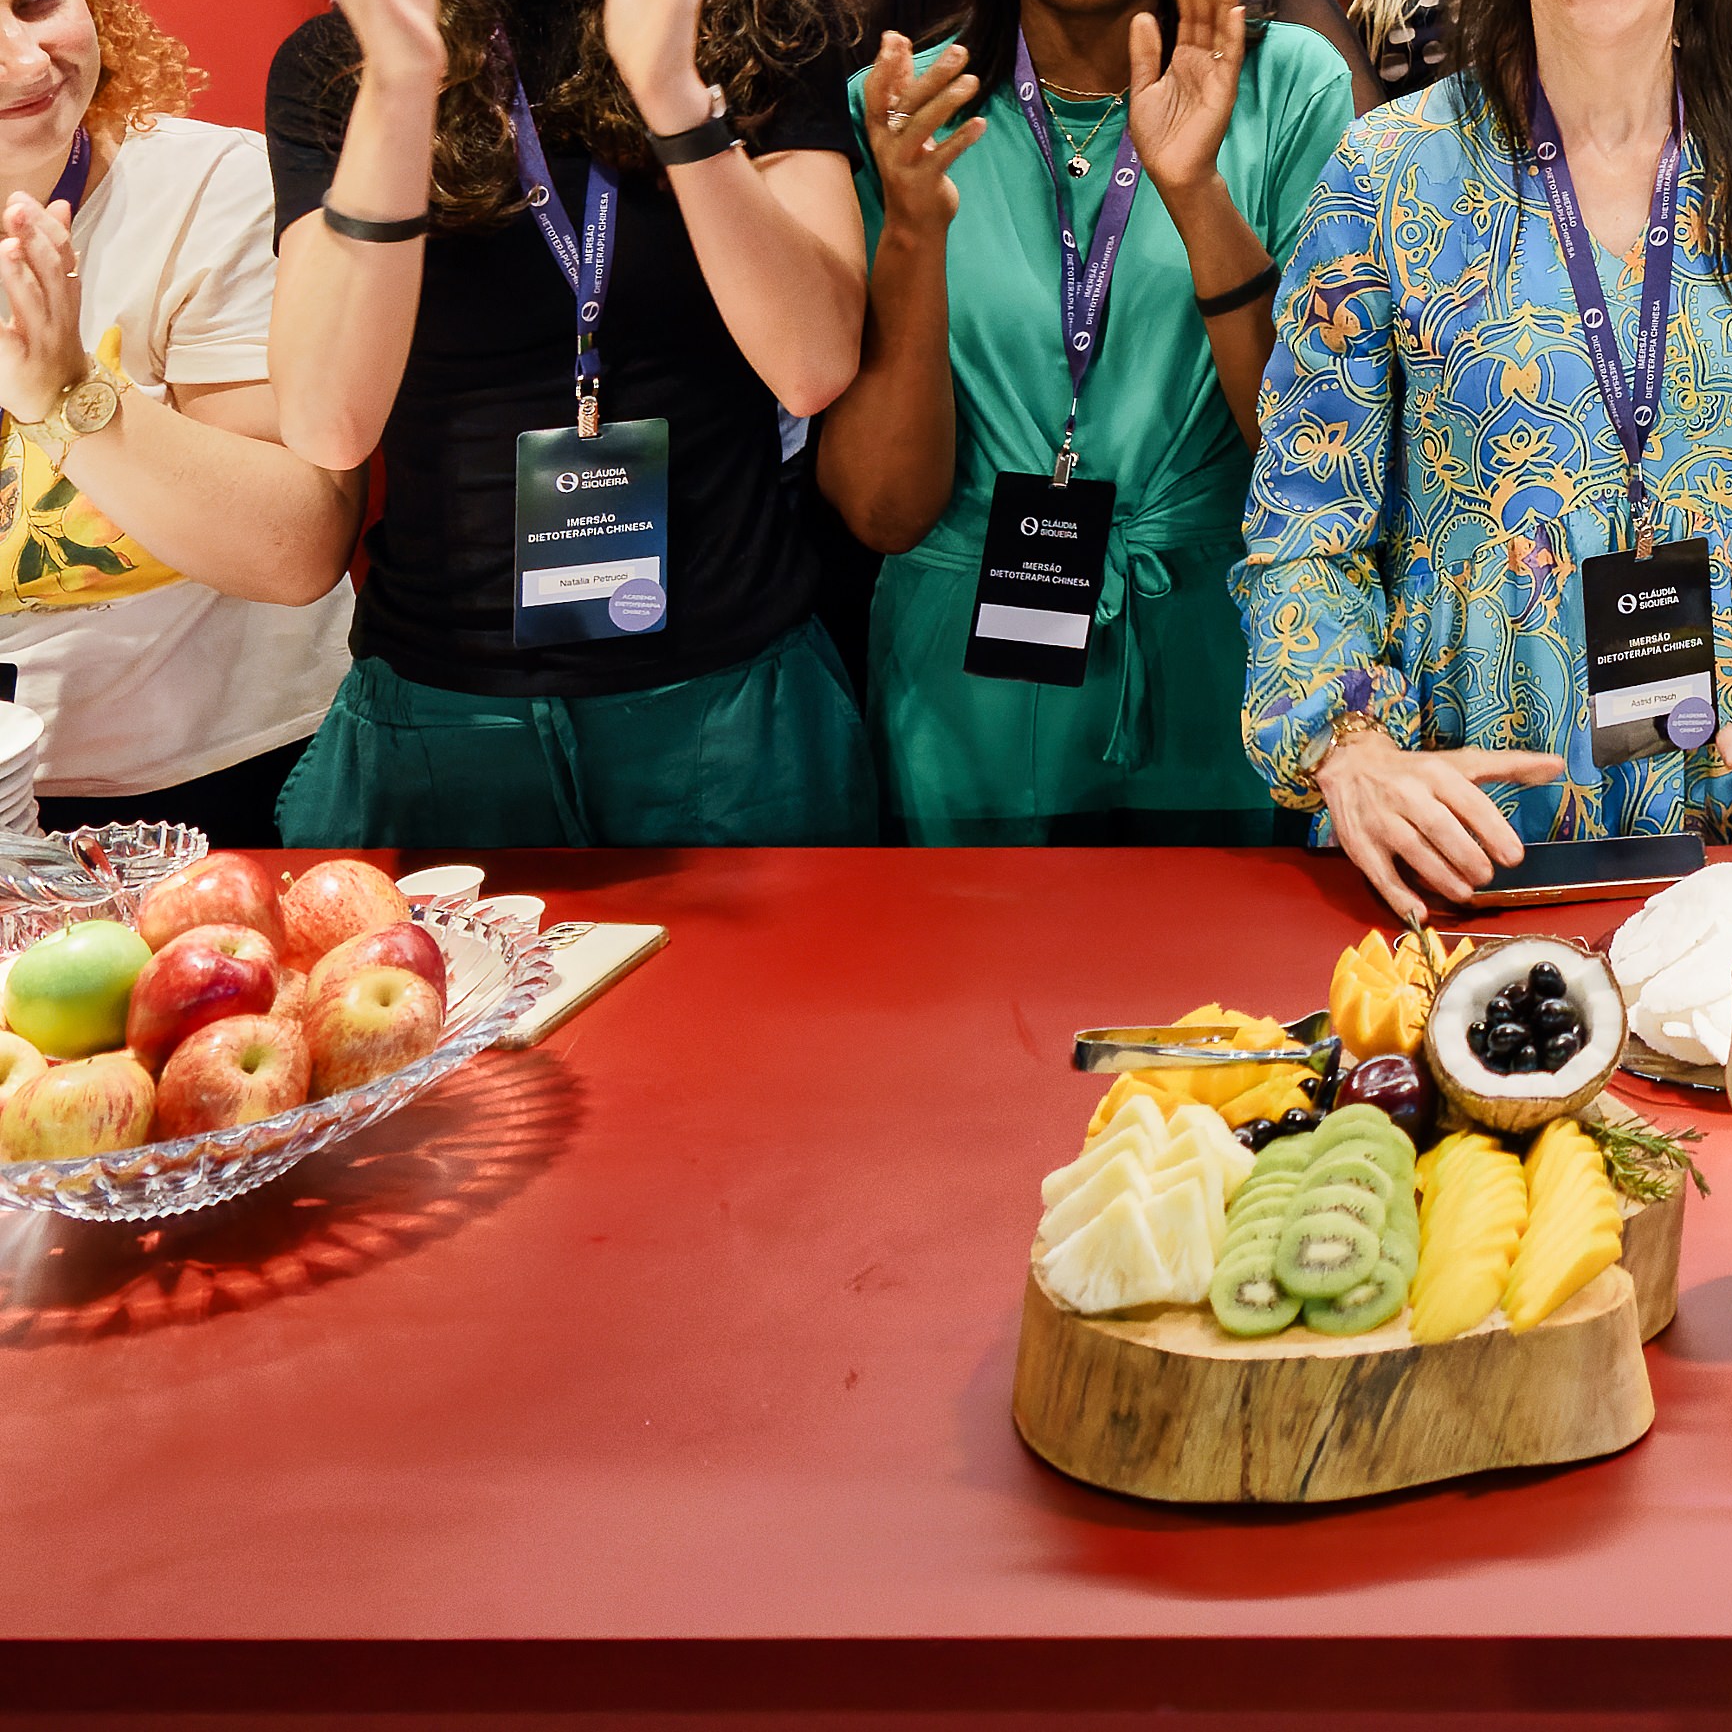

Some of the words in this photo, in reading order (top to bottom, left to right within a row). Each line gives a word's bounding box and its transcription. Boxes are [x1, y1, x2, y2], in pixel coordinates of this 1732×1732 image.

[593, 232, 606, 294] DIETOTERAPIA
[582, 467, 627, 480] CLÁUDIA
[582, 476, 629, 489] SIQUEIRA
[567, 513, 616, 527] IMERSÃO
[1041, 519, 1078, 530] CLÁUDIA
[528, 526, 605, 543] DIETOTERAPIA
[606, 521, 654, 535] CHINESA
[1022, 562, 1062, 573] IMERSÃO
[560, 578, 590, 588] Natalia
[990, 569, 1051, 583] DIETOTERAPIA
[1052, 576, 1090, 587] CHINESA
[1639, 586, 1677, 601] CLÁUDIA
[1639, 595, 1680, 610] SIQUEIRA
[1629, 632, 1671, 648] IMERSÃO
[1597, 648, 1662, 665] DIETOTERAPIA
[1663, 637, 1704, 653] CHINESA
